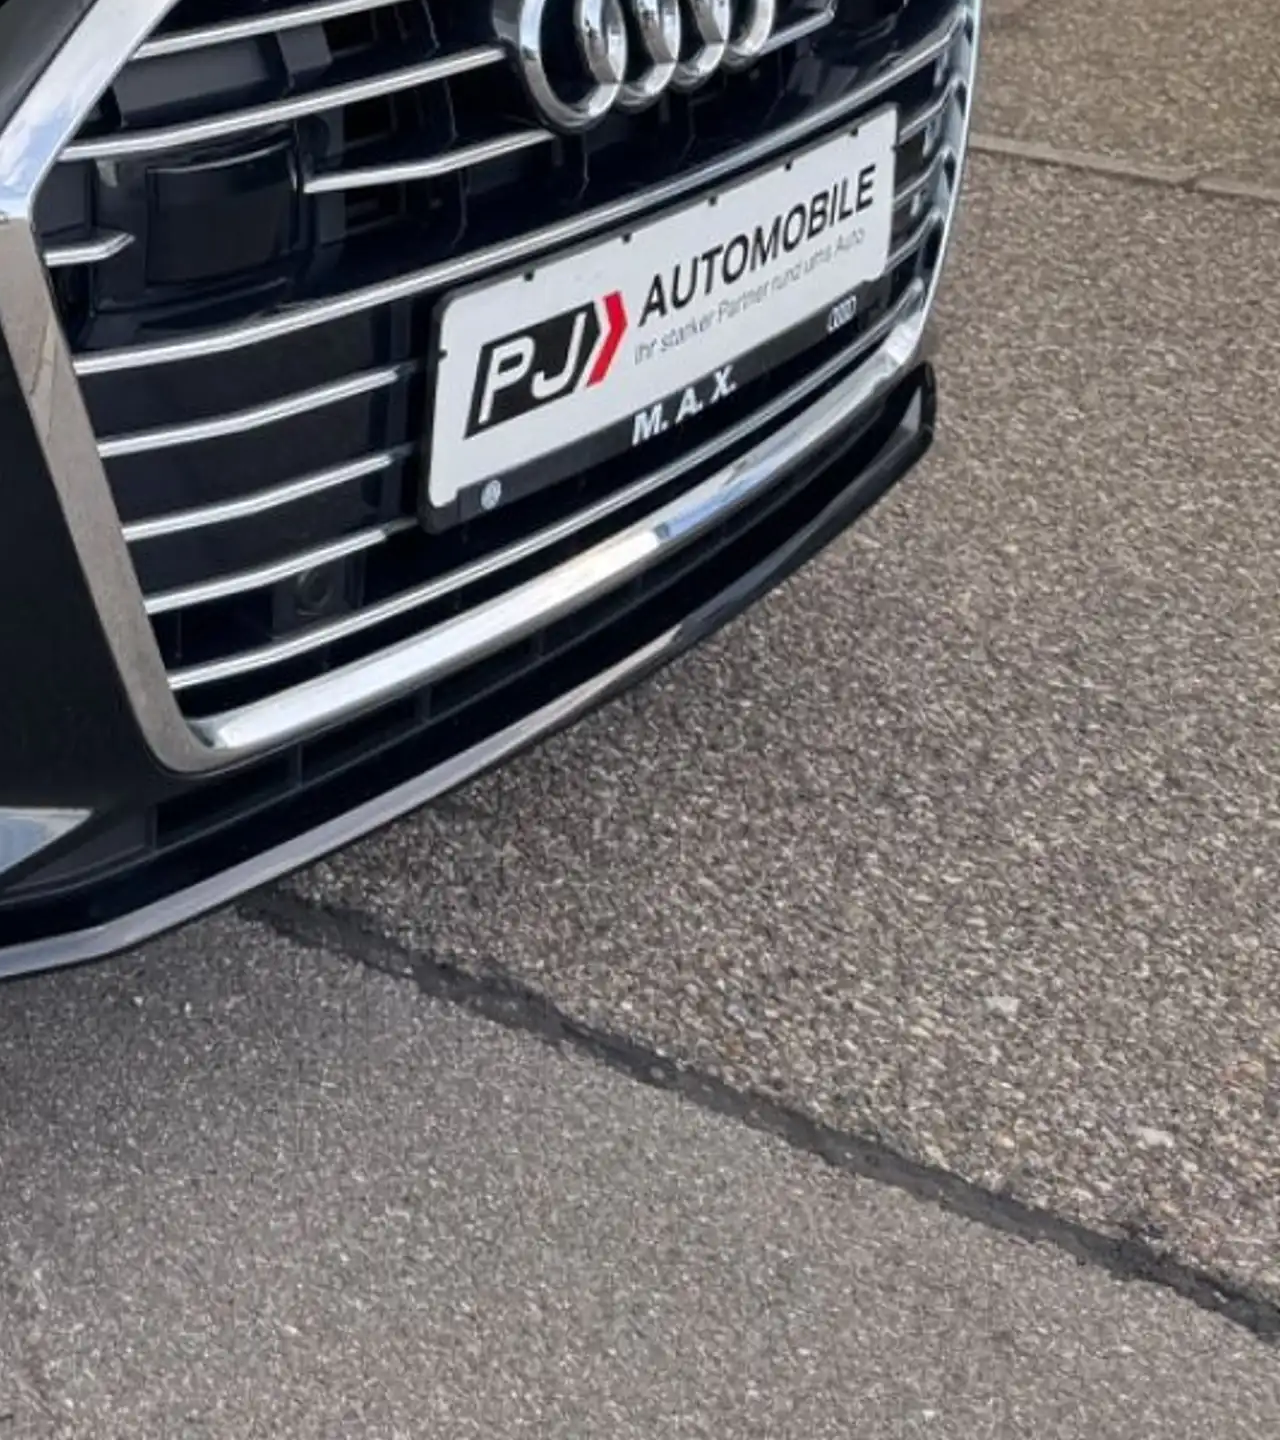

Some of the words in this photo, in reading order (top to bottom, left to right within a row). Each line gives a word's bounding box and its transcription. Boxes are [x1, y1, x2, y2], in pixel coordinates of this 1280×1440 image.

[634, 337, 657, 366] Ihr
[718, 281, 769, 325] Partner
[834, 227, 865, 258] Auto
[638, 163, 876, 328] AUTOMOBILE
[478, 312, 588, 425] PJ
